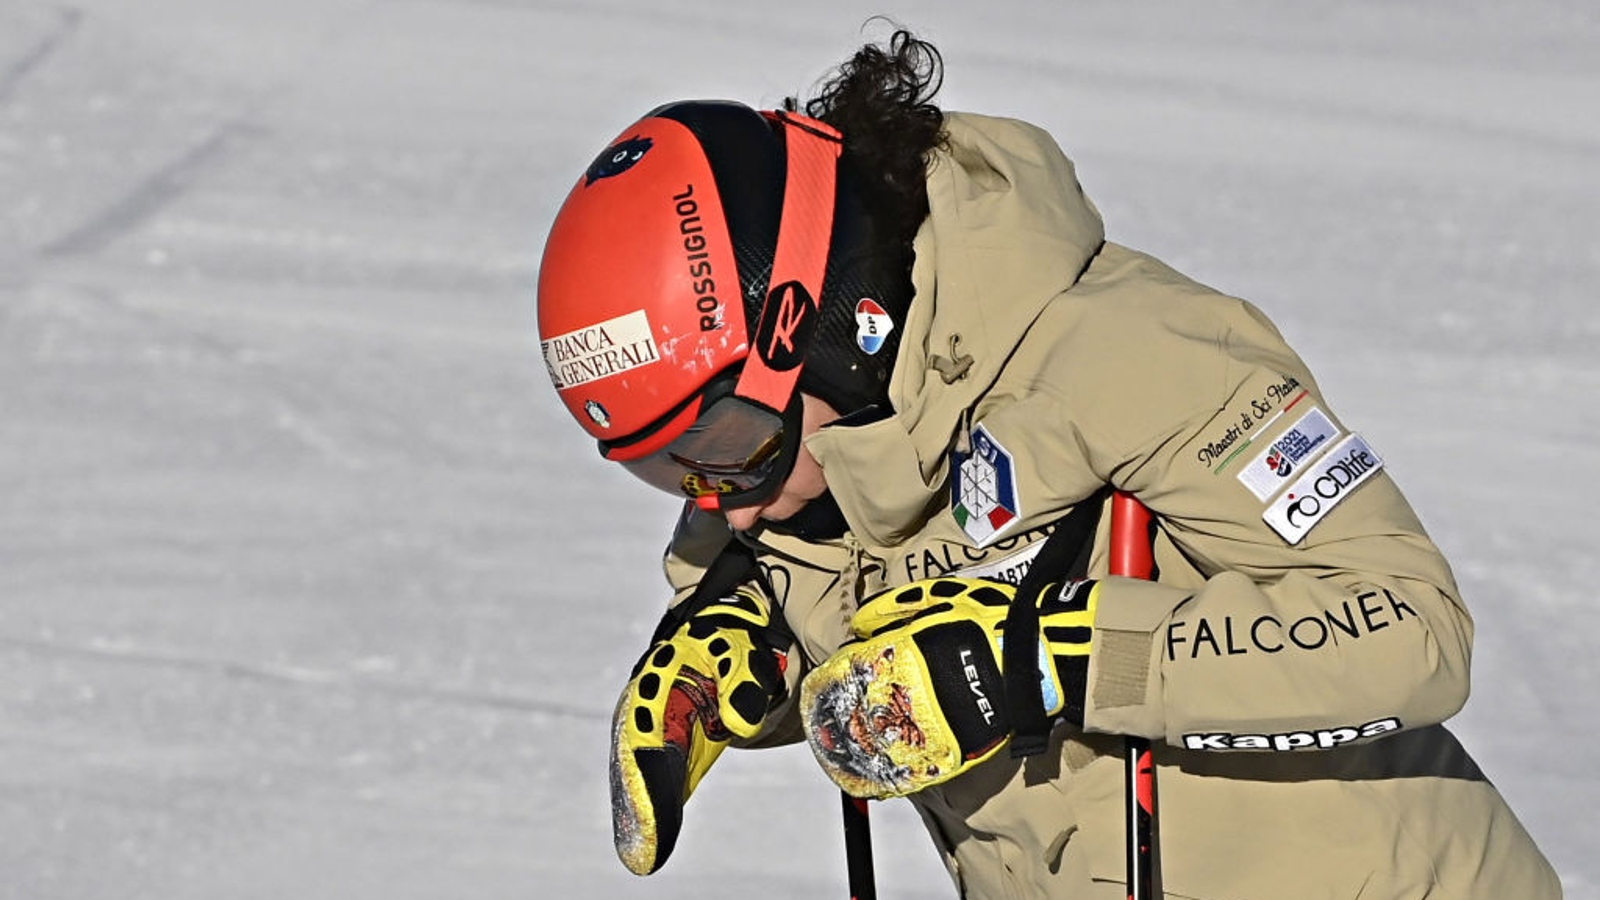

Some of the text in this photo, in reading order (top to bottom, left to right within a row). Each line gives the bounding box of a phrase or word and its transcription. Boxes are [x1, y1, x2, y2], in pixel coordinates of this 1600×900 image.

[673, 184, 721, 331] ROSSIGNOL
[553, 326, 615, 361] BANCA
[560, 339, 656, 385] GENERALI
[1277, 429, 1301, 450] 2021
[960, 650, 994, 725] LEVEL
[1182, 717, 1402, 752] Kappa
